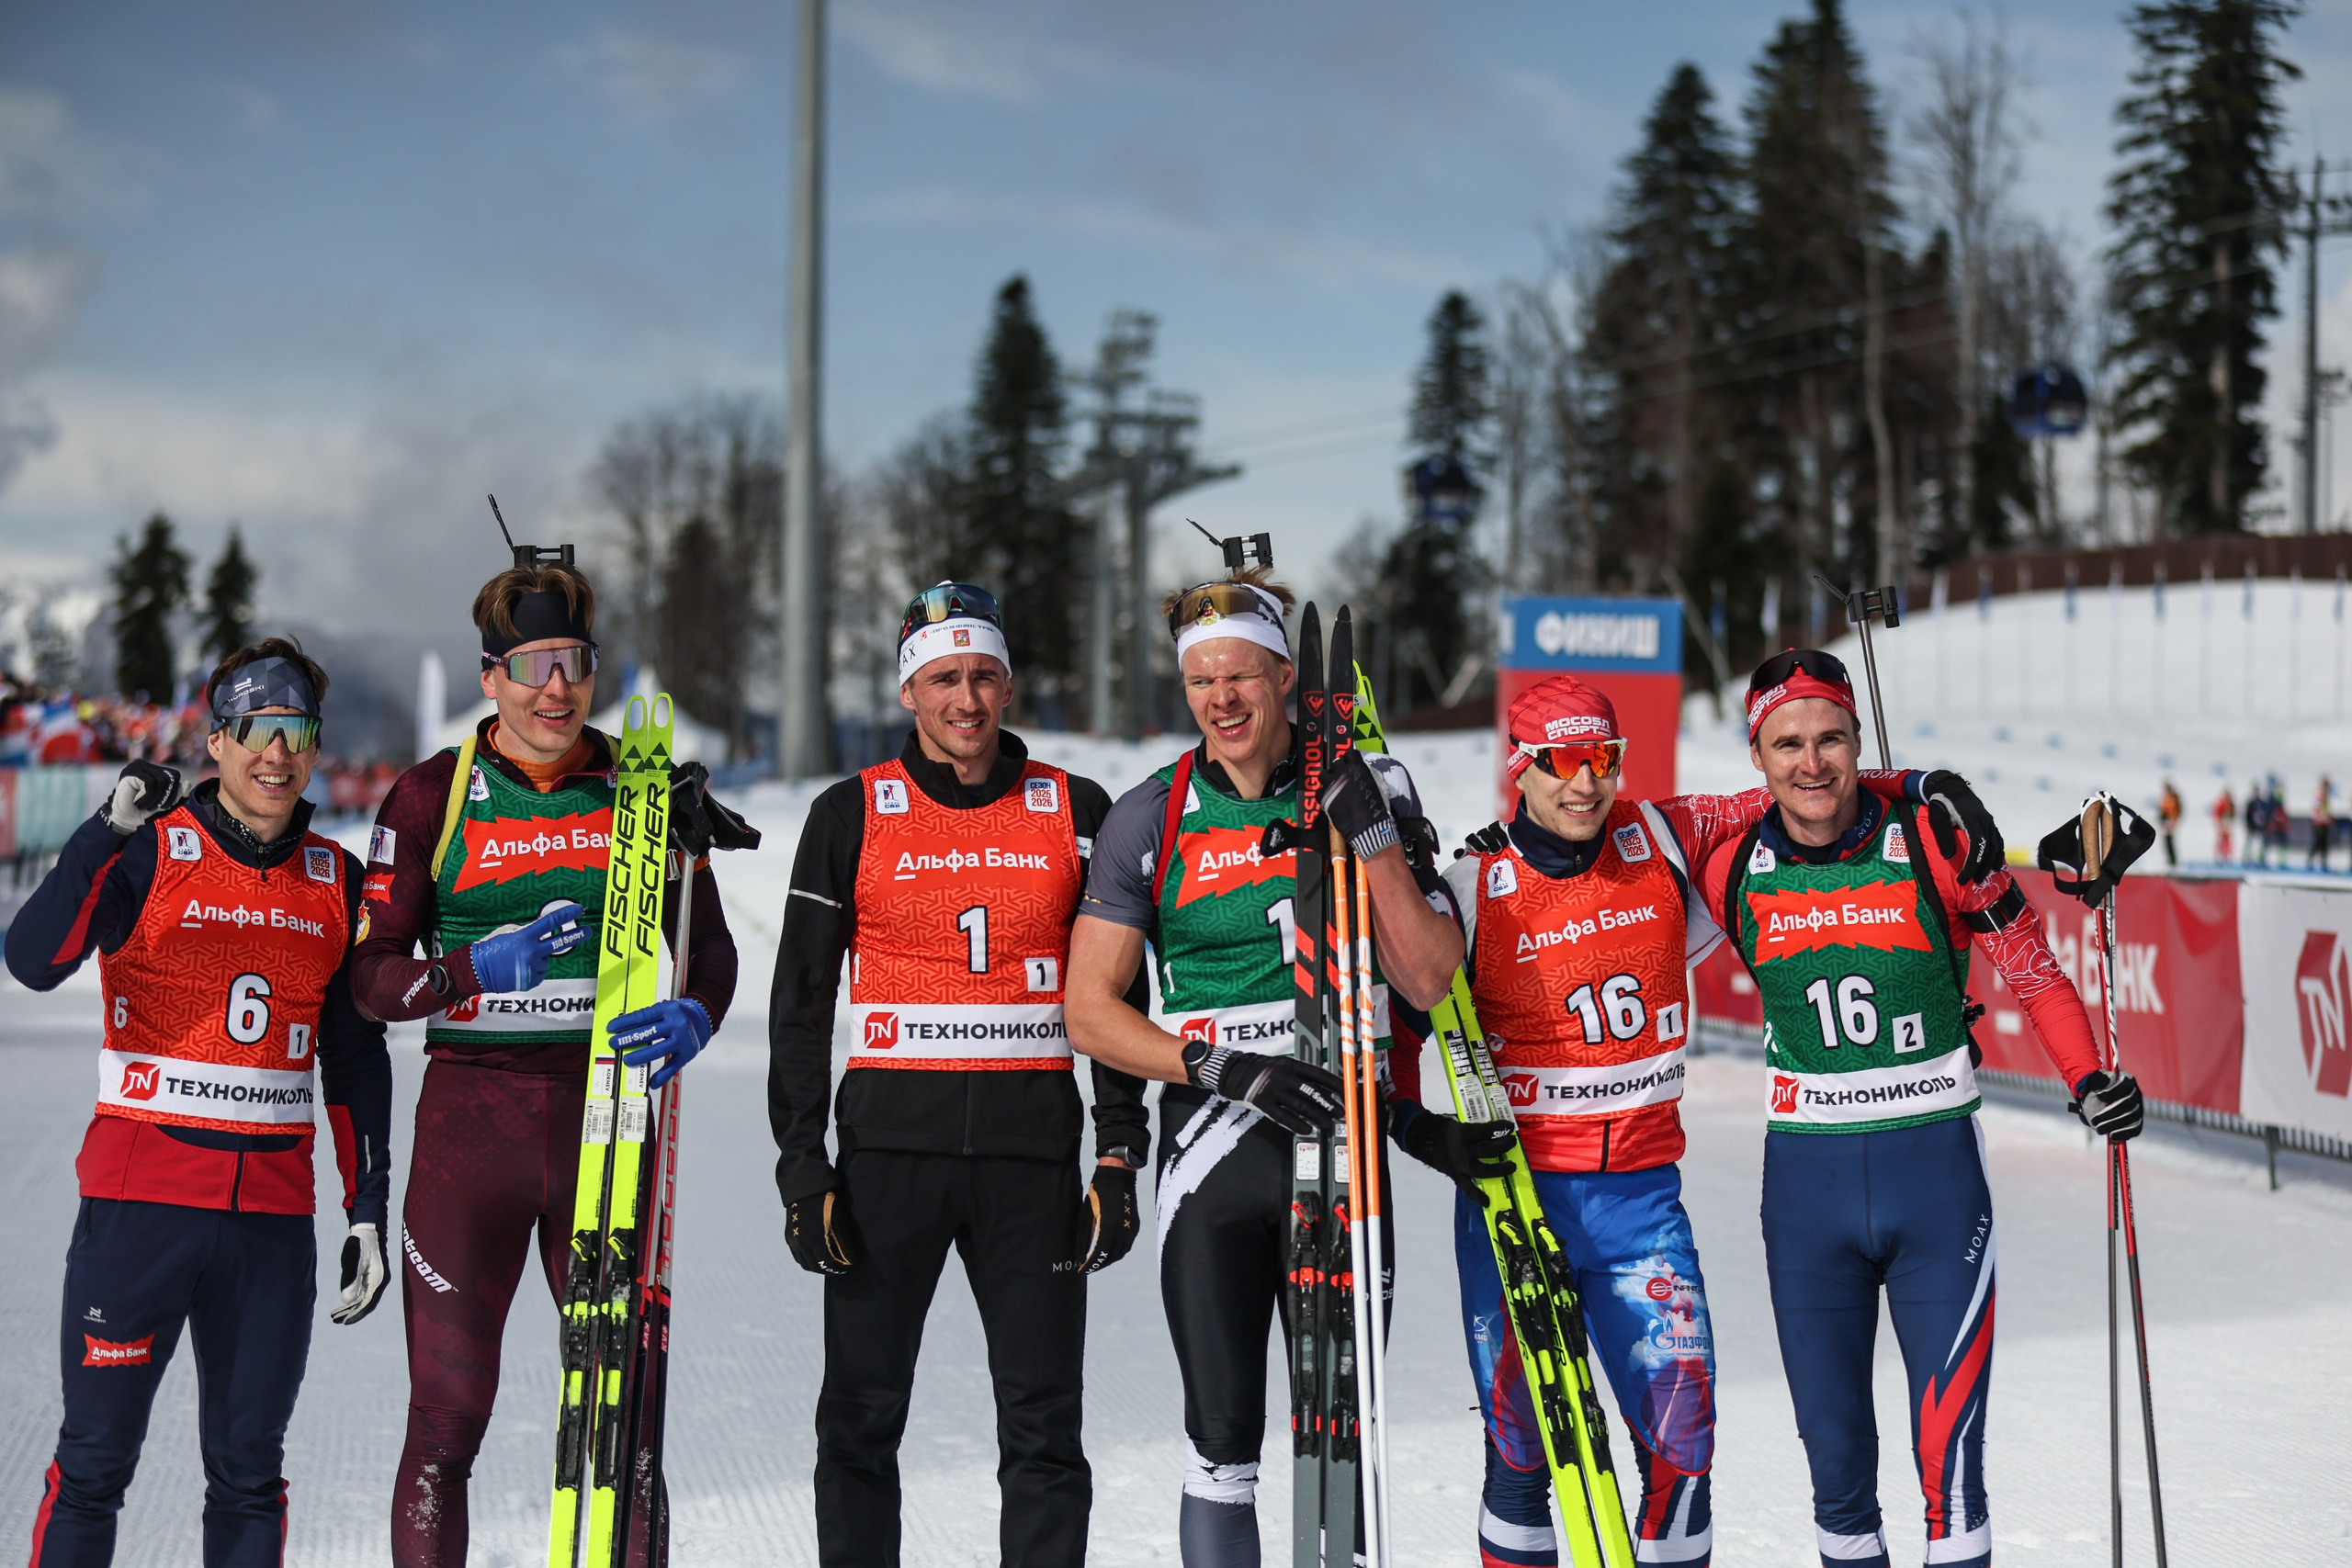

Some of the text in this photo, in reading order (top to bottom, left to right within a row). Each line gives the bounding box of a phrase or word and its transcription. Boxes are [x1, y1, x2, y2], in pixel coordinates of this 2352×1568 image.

[1533, 611, 1660, 659] ФИНИШ
[227, 684, 265, 704] NORDSKI
[1547, 725, 1600, 741] СПОРТ
[1030, 782, 1051, 790] СЕЗОН
[1030, 788, 1052, 799] 2025
[1031, 797, 1053, 807] 2026
[480, 832, 567, 860] Альфа
[1617, 827, 1638, 840] СЕЗОН
[1620, 834, 1642, 848] 2025
[1890, 836, 1906, 847] 202
[308, 850, 330, 859] СЕЗОН
[310, 857, 330, 869] 2025
[895, 847, 1051, 874] Альфа Банк
[1197, 840, 1282, 874] Альф
[1624, 844, 1645, 857] 2026
[311, 866, 331, 878] 2026
[605, 784, 639, 959] FISCHER
[636, 782, 666, 958] FISCHER
[181, 899, 325, 939] Альфа Банк
[1516, 904, 1659, 956] Альфа Банк
[1768, 902, 1906, 934] Альфа Банк
[957, 905, 989, 975] 1
[853, 953, 861, 985] 1
[1035, 962, 1047, 987] 1
[1163, 961, 1175, 994] 1
[401, 970, 430, 1009] protea
[113, 996, 130, 1029] 6
[225, 971, 273, 1045] 6
[486, 998, 596, 1013] ТЕХНОНИ
[1565, 973, 1647, 1045] 16
[1804, 973, 1880, 1050] 16
[1664, 1010, 1674, 1034] 1
[1902, 1021, 1917, 1048] 2
[296, 1029, 304, 1055] 1
[165, 1077, 314, 1105] ТЕХНОНИКОЛЬ
[1544, 1060, 1686, 1100] ТЕХНОНИКОЛЬ
[1803, 1075, 1957, 1107] ТЕХНОНИКОЛЬ
[1963, 1213, 1991, 1265] MOAX
[91, 1346, 148, 1360] Альфа Банк
